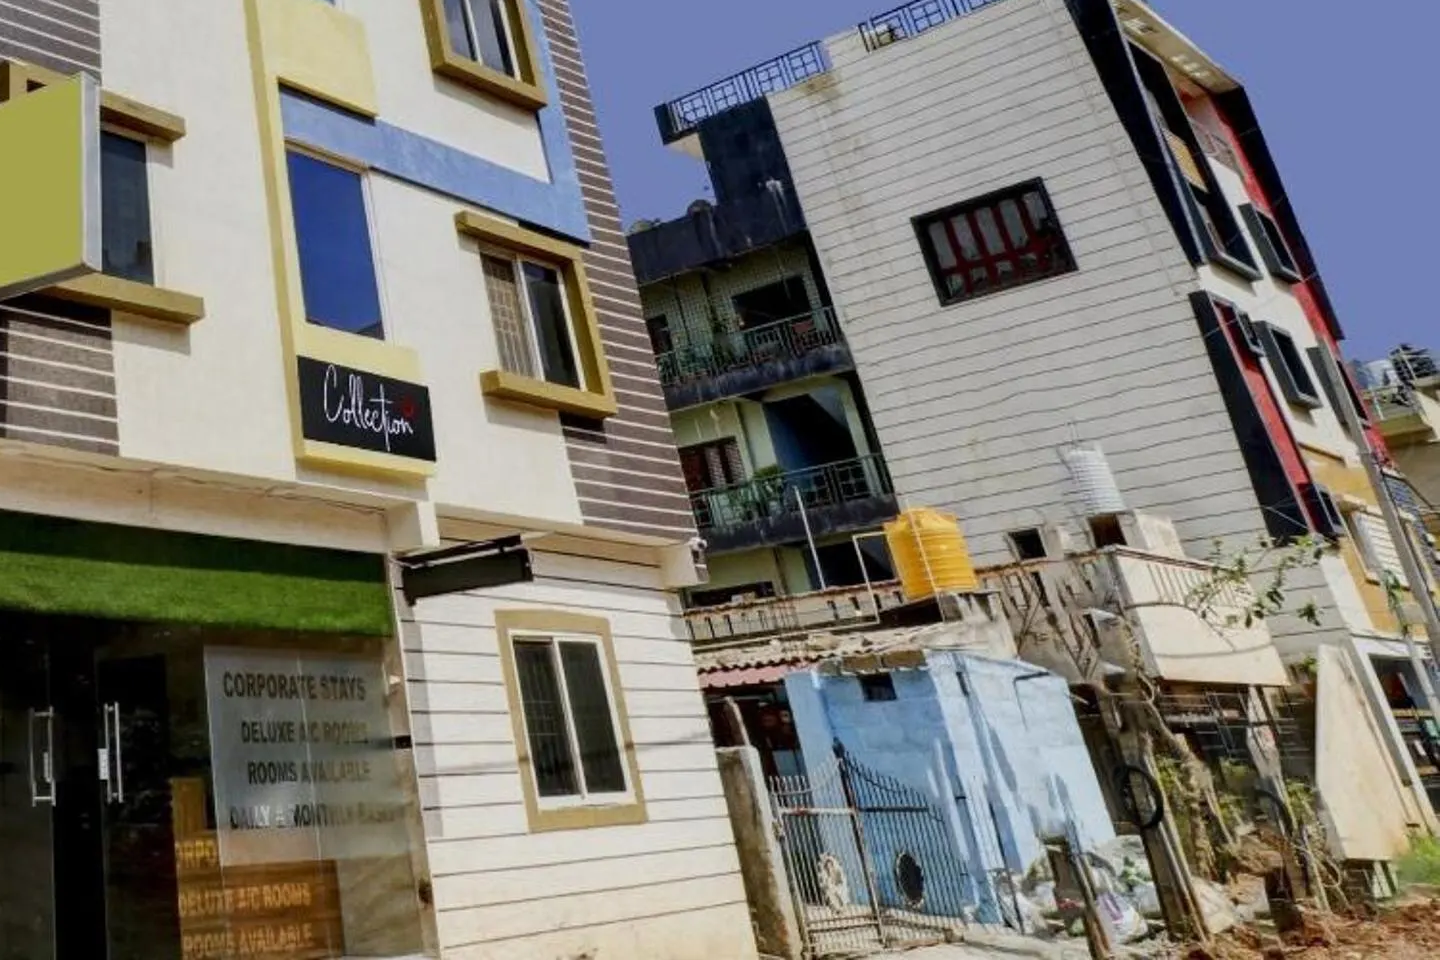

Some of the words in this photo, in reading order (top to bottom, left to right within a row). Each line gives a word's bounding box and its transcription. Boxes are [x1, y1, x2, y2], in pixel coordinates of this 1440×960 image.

[323, 365, 413, 452] Collection
[222, 671, 317, 699] CORPORATE
[319, 675, 367, 701] STAYS
[241, 720, 295, 744] DELUXE
[248, 761, 298, 785] ROOMS
